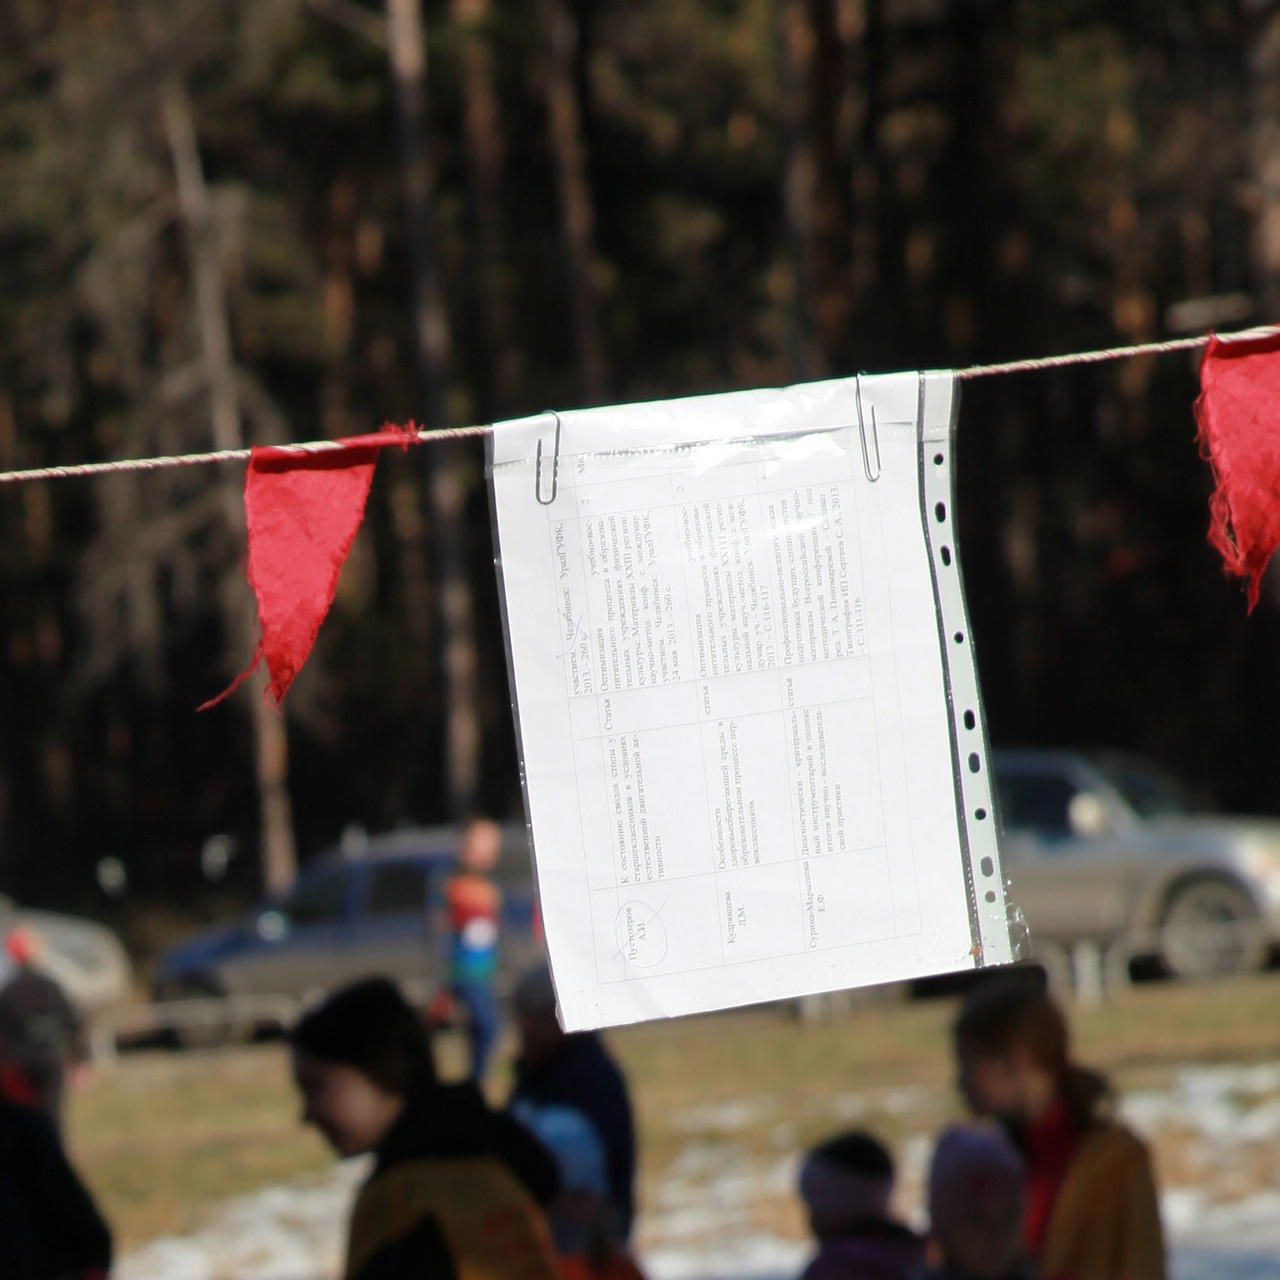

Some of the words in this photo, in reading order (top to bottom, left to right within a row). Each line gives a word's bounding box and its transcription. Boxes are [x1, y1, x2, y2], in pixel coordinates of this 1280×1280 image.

[727, 498, 735, 522] меж-
[805, 487, 813, 505] под
[607, 515, 622, 571] физической
[780, 498, 794, 563] специистов
[768, 504, 793, 664] Профессионально-педагогиеская
[797, 532, 812, 604] Всероссийской
[838, 539, 848, 578] Сергеев
[603, 577, 615, 621] процесса
[616, 578, 630, 641] учреждениях
[628, 582, 639, 637] Материалы
[700, 564, 713, 607] процесса
[712, 564, 727, 628] учреждениях
[724, 569, 736, 621] материалы
[789, 565, 800, 608] будущих
[839, 579, 848, 597] ИП
[695, 613, 707, 677] Оптимизация
[706, 611, 718, 675] питательного
[741, 631, 753, 670] нальной
[794, 610, 805, 663] подготовка
[807, 610, 817, 661] материалы
[816, 593, 829, 659] методической
[842, 598, 854, 656] Типография
[596, 627, 609, 691] Оптимизация
[608, 626, 621, 689] питательного
[623, 648, 633, 688] тельных
[720, 634, 730, 674] тельных
[603, 697, 613, 730] Статья
[702, 684, 711, 715] статья
[786, 676, 794, 707] статья
[718, 731, 729, 760] среды
[728, 719, 737, 740] пер-
[791, 710, 802, 767] критериаль-
[802, 708, 811, 741] оценке
[816, 706, 827, 776] исследователь-
[608, 748, 618, 778] стопы
[619, 734, 632, 779] условиях
[632, 751, 646, 814] двигательной
[731, 741, 742, 784] процессе
[612, 782, 622, 814] сводов
[720, 764, 738, 867] здоровьесберегающей
[796, 780, 810, 856] Диагностически
[805, 754, 819, 831] инструментарий
[822, 785, 831, 819] научно
[834, 783, 845, 827] практики
[616, 819, 627, 871] состоянию
[626, 795, 641, 882] старшеклассников
[639, 817, 652, 880] естественной
[714, 807, 726, 869] Особенности
[735, 786, 749, 865] образовательном
[748, 799, 760, 864] воклассников
[812, 834, 821, 854] ный
[825, 820, 833, 852] итогов
[836, 828, 846, 850] ской
[620, 875, 629, 884] К
[654, 835, 664, 879] тивности
[724, 890, 736, 944] Кудрявцева
[802, 860, 818, 948] Сурина-Марышева
